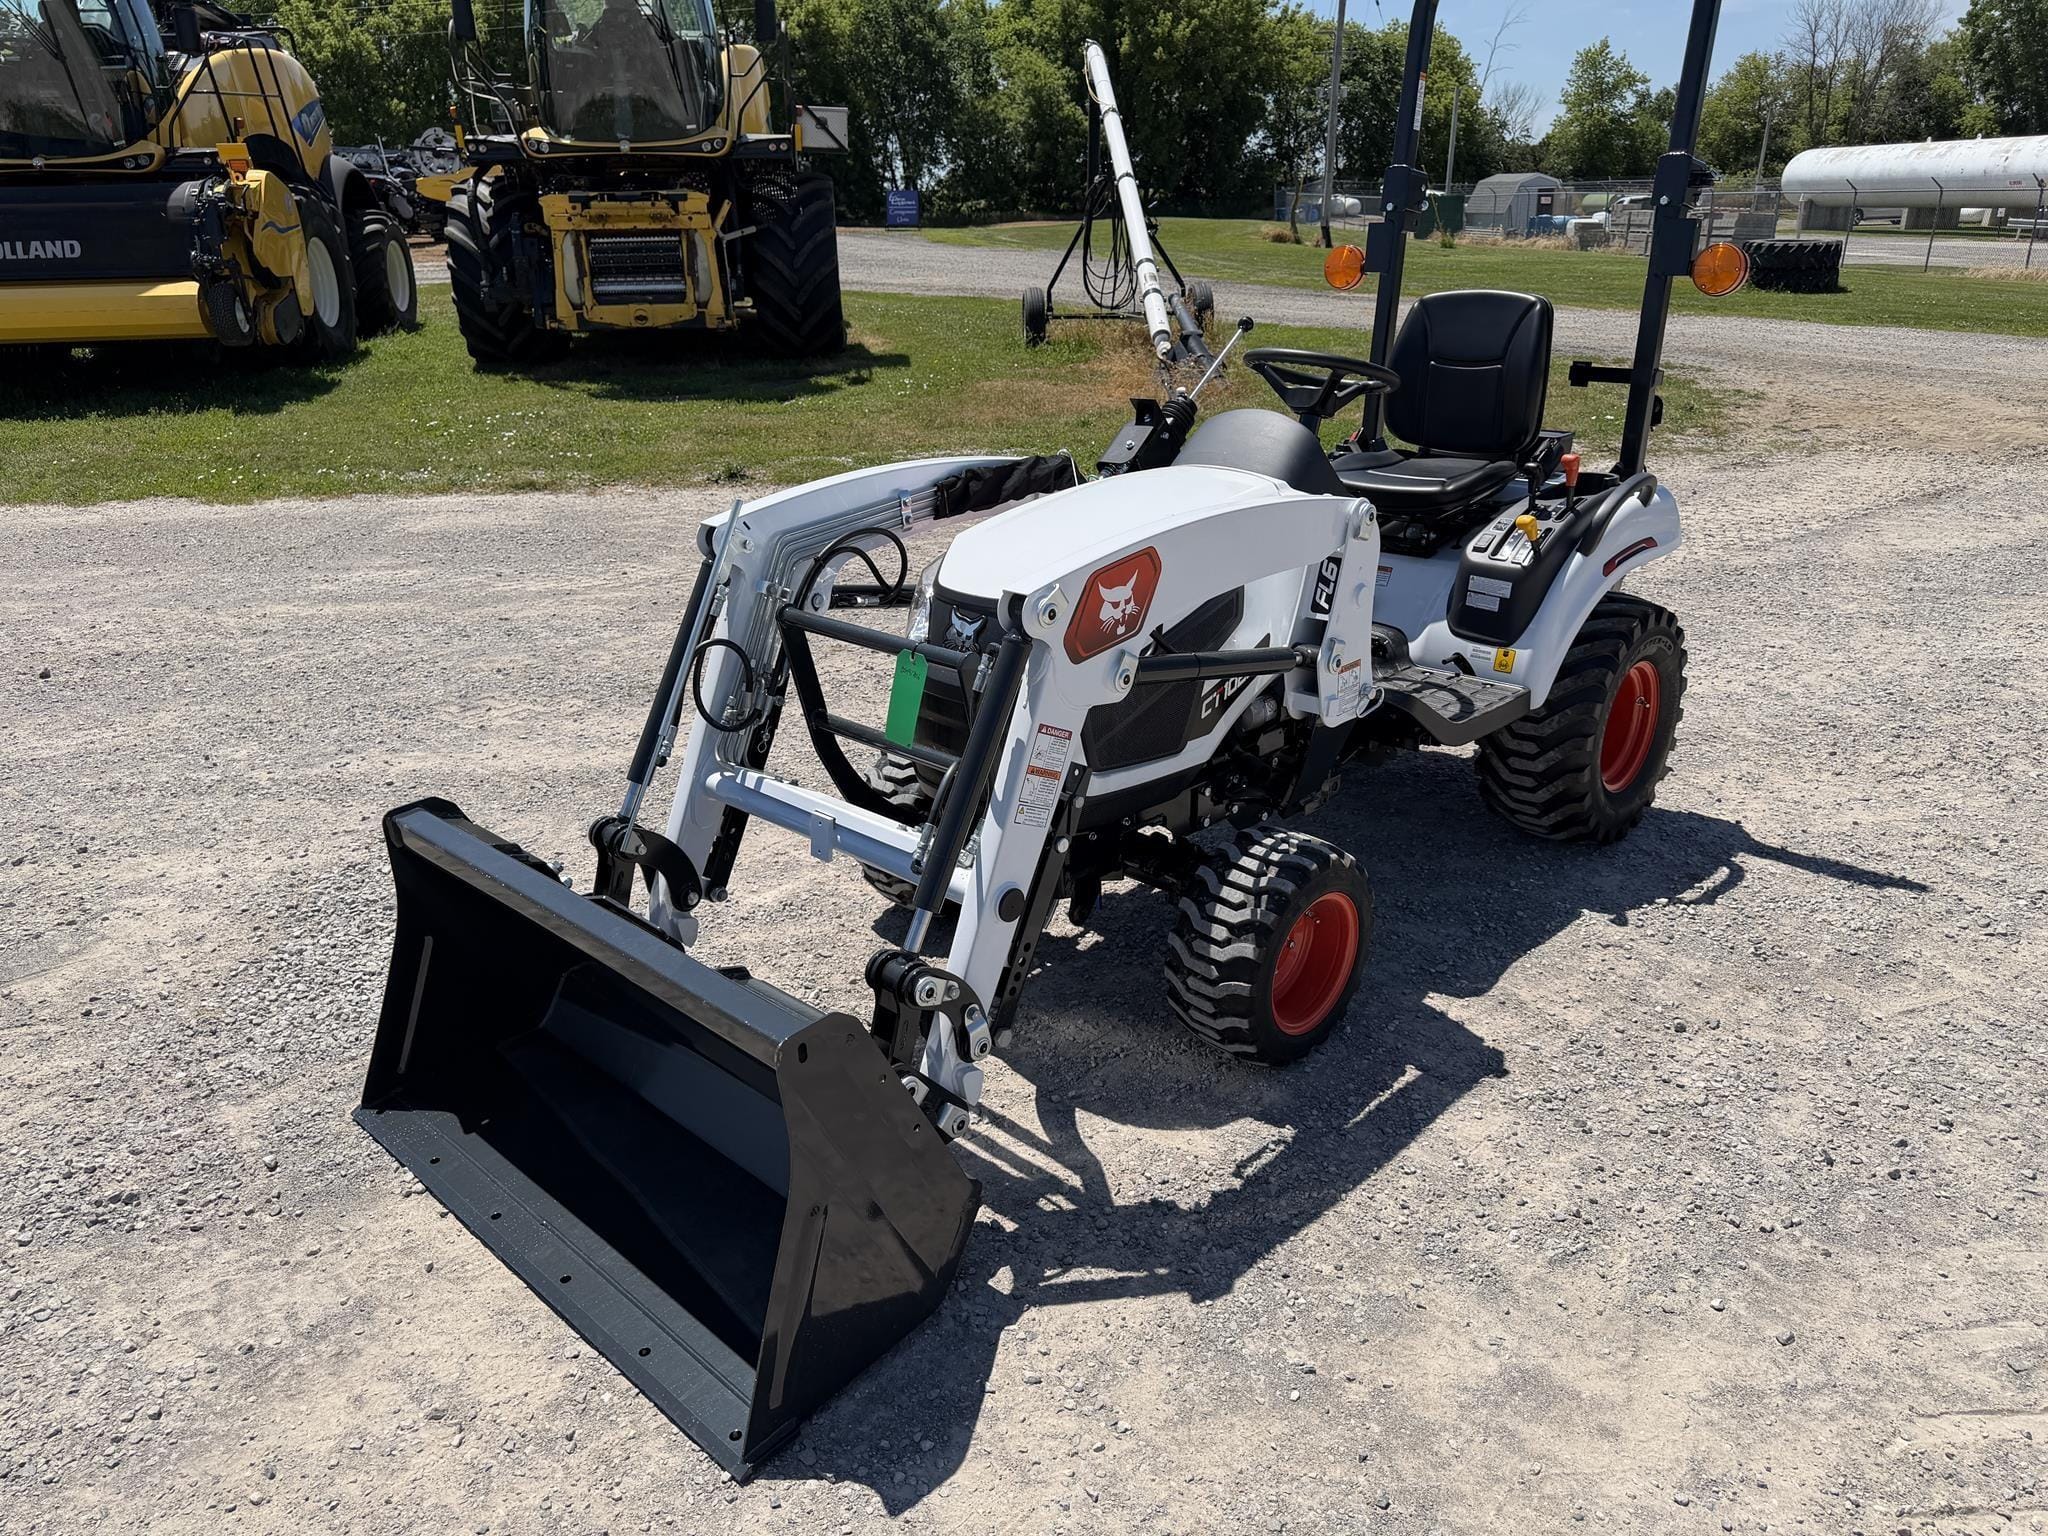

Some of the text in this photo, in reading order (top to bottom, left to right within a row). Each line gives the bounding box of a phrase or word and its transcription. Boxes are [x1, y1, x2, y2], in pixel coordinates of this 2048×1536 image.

[0, 240, 81, 259] LLAND
[1315, 559, 1338, 610] FL6
[1047, 727, 1069, 738] DANGER
